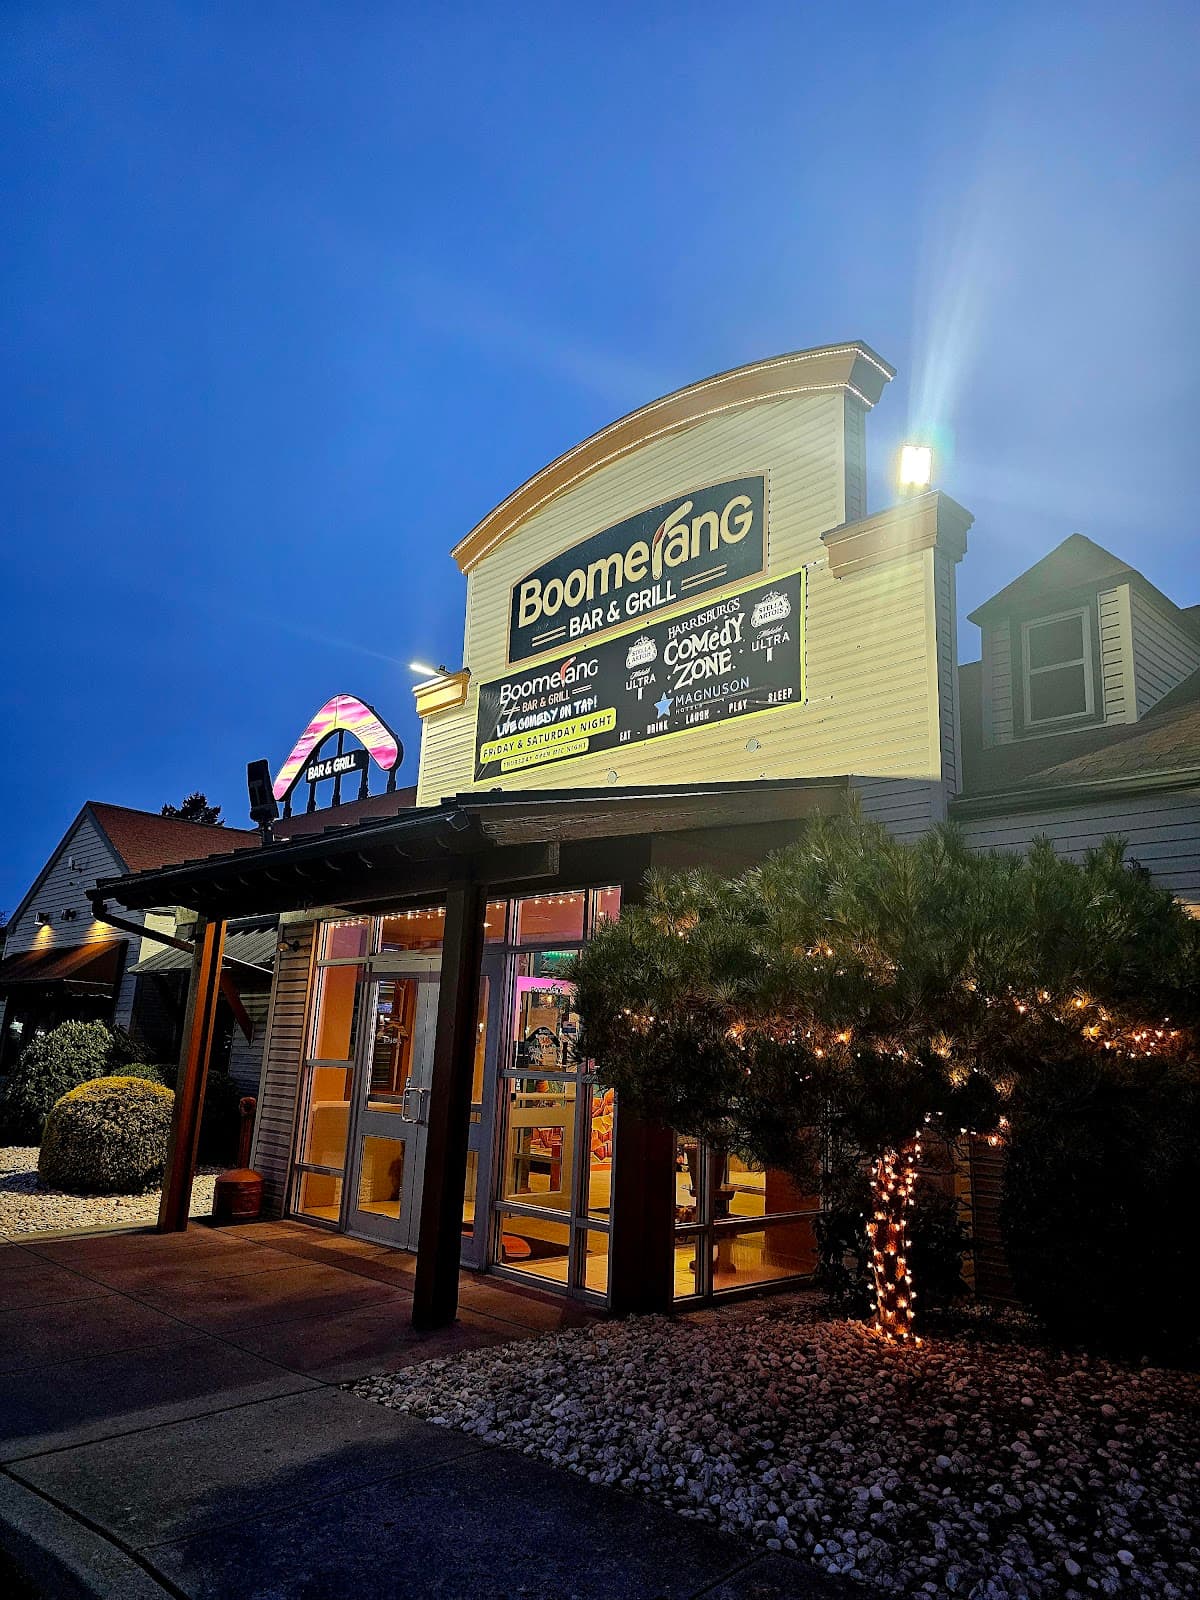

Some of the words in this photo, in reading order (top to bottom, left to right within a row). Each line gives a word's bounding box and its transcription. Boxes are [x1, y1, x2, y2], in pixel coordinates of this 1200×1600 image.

[569, 608, 603, 637] BAR
[607, 600, 621, 623] &
[625, 580, 677, 615] GRILL
[668, 598, 741, 640] HARRISBURGS
[751, 631, 791, 651] ULTRA
[625, 673, 656, 690] ULTRA
[675, 676, 750, 707] MAGNUSON
[496, 720, 517, 737] LIVE
[518, 707, 558, 730] COMEDY
[560, 704, 571, 719] ON
[573, 695, 598, 714] TAP!
[522, 701, 538, 713] BAR
[539, 697, 547, 708] &
[548, 690, 570, 705] GRILL
[619, 730, 631, 742] EAT
[728, 699, 748, 714] PLAY
[767, 687, 793, 703] SLEEP
[483, 743, 515, 758] FRIDAY
[517, 740, 523, 749] &
[527, 725, 577, 747] SATURDAY
[580, 715, 612, 731] NIGHT
[307, 765, 325, 780] BAR
[325, 761, 332, 774] &
[333, 754, 356, 772] GRILL
